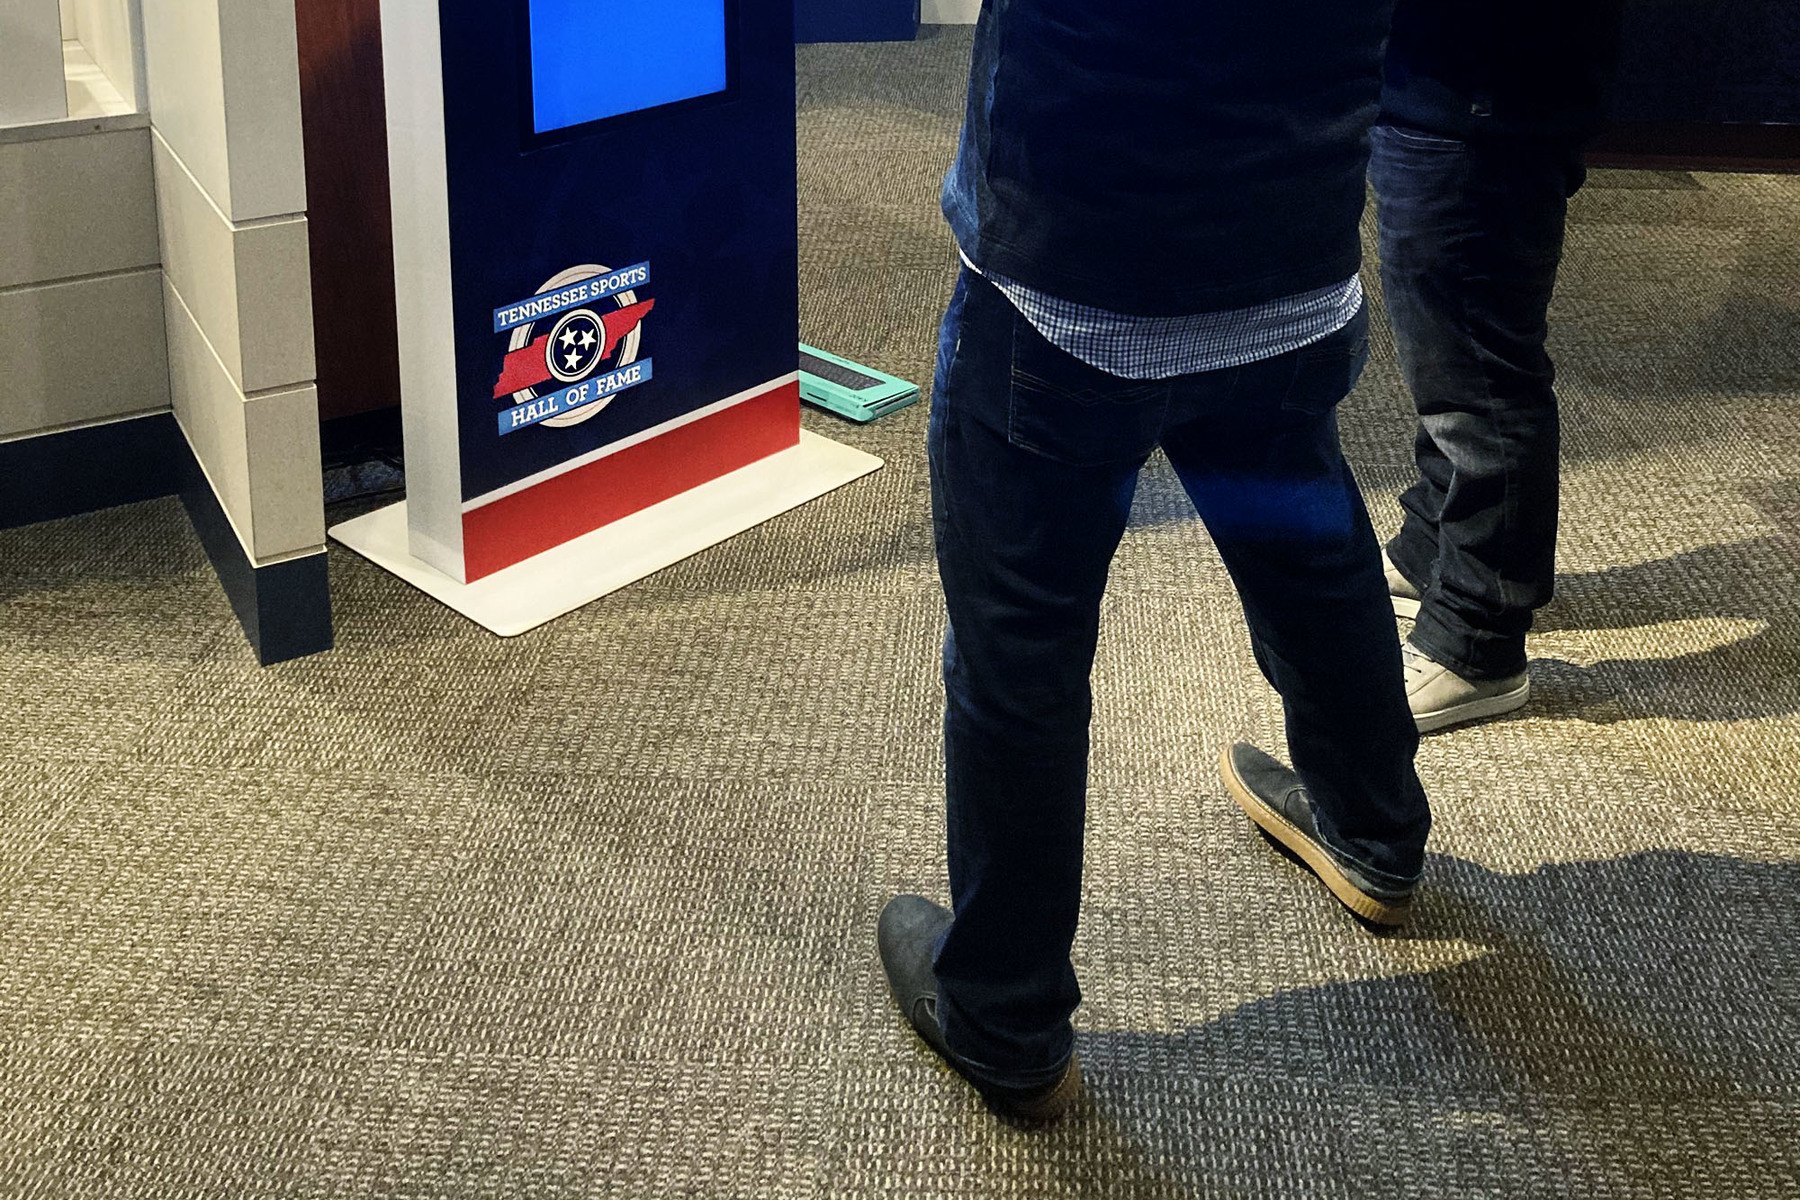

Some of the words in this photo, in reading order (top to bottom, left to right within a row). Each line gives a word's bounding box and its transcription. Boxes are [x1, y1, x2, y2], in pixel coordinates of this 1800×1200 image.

[498, 284, 588, 326] TENNESSEE
[591, 267, 647, 296] SPORTS
[511, 397, 559, 427] HALL
[566, 384, 589, 406] OF
[596, 366, 641, 395] FAME
